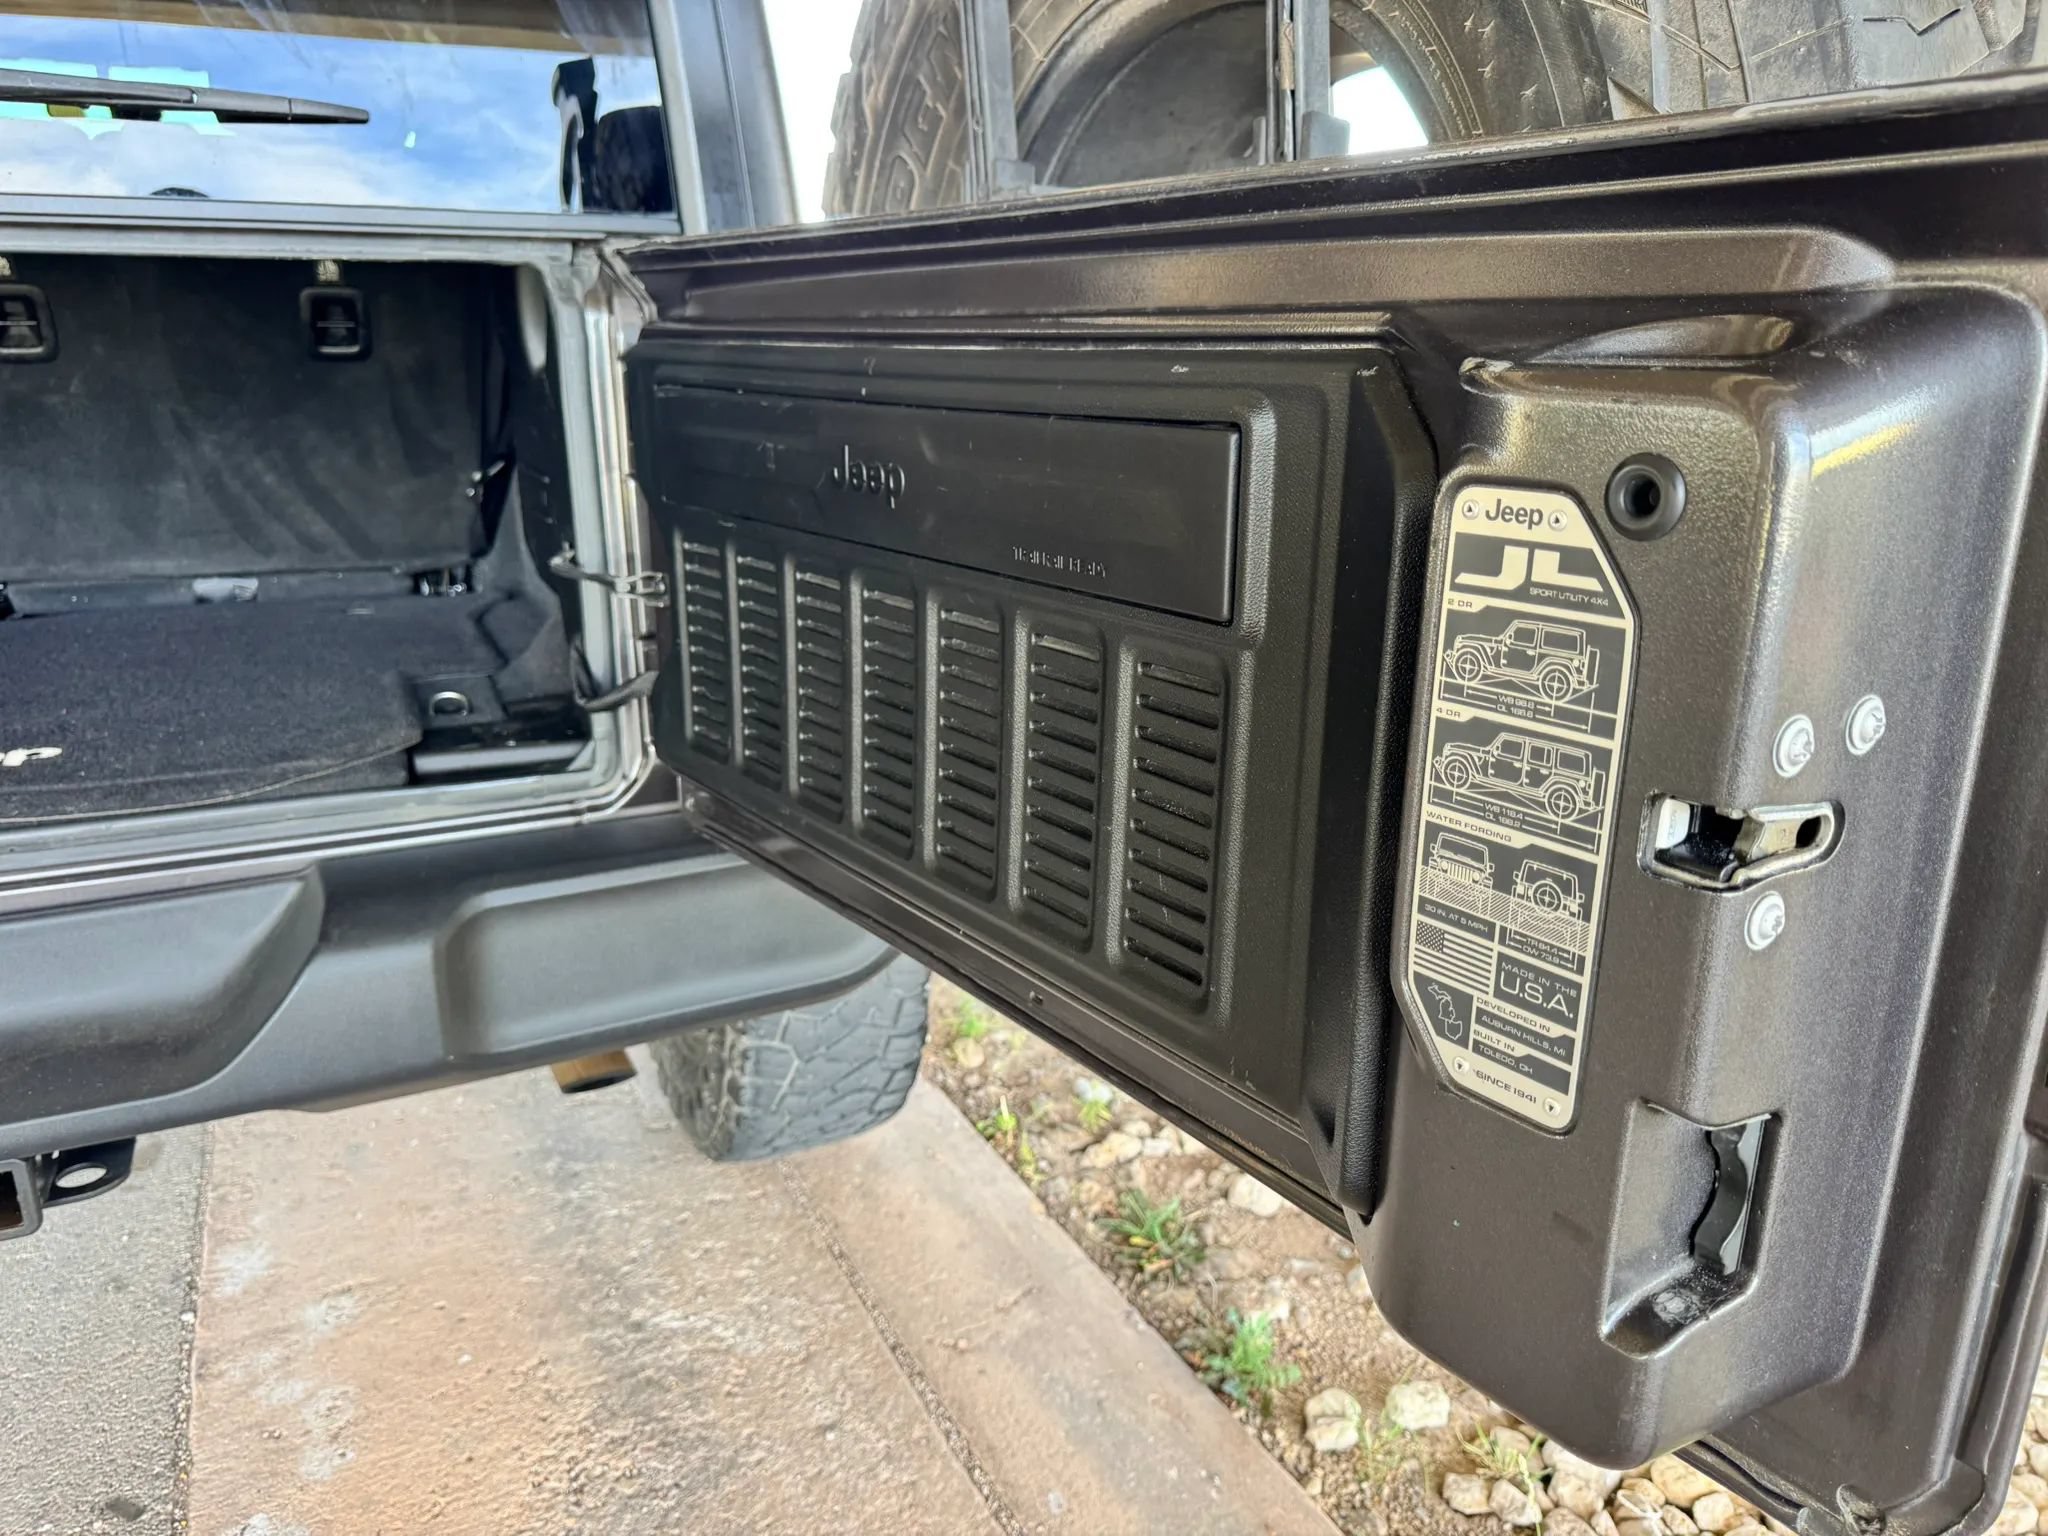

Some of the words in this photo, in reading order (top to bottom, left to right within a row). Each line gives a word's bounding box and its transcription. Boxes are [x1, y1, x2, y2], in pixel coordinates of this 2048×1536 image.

[1485, 498, 1544, 530] Jeep
[1454, 545, 1604, 592] JL
[1447, 598, 1455, 606] 2
[1457, 599, 1473, 609] DR
[1529, 587, 1557, 599] SPORT
[1558, 590, 1590, 604] UTILITY
[1590, 595, 1609, 607] 4X4
[1445, 709, 1462, 719] DR
[1498, 694, 1514, 705] WB
[1484, 802, 1500, 813] WB
[1426, 810, 1462, 829] WATER
[1464, 819, 1513, 843] FORDING
[1424, 903, 1437, 913] 30
[1447, 912, 1459, 921] AT
[1467, 919, 1489, 933] MPH
[1499, 970, 1575, 1019] U.S.A.
[1501, 961, 1535, 981] MADE
[1538, 975, 1551, 988] IN
[1554, 982, 1578, 998] THE
[1476, 996, 1537, 1028] DEVELOPED
[1539, 1022, 1552, 1034] IN
[1473, 1028, 1502, 1047] BUILT
[1503, 1041, 1516, 1053] IN
[1481, 1014, 1522, 1038] AUBURN
[1523, 1028, 1552, 1050] HILLS,
[1553, 1045, 1567, 1057] MI
[1478, 1043, 1517, 1068] TOLEDO,
[1518, 1061, 1534, 1075] OH
[1475, 1069, 1511, 1093] SINCE
[1512, 1087, 1538, 1104] 1941
